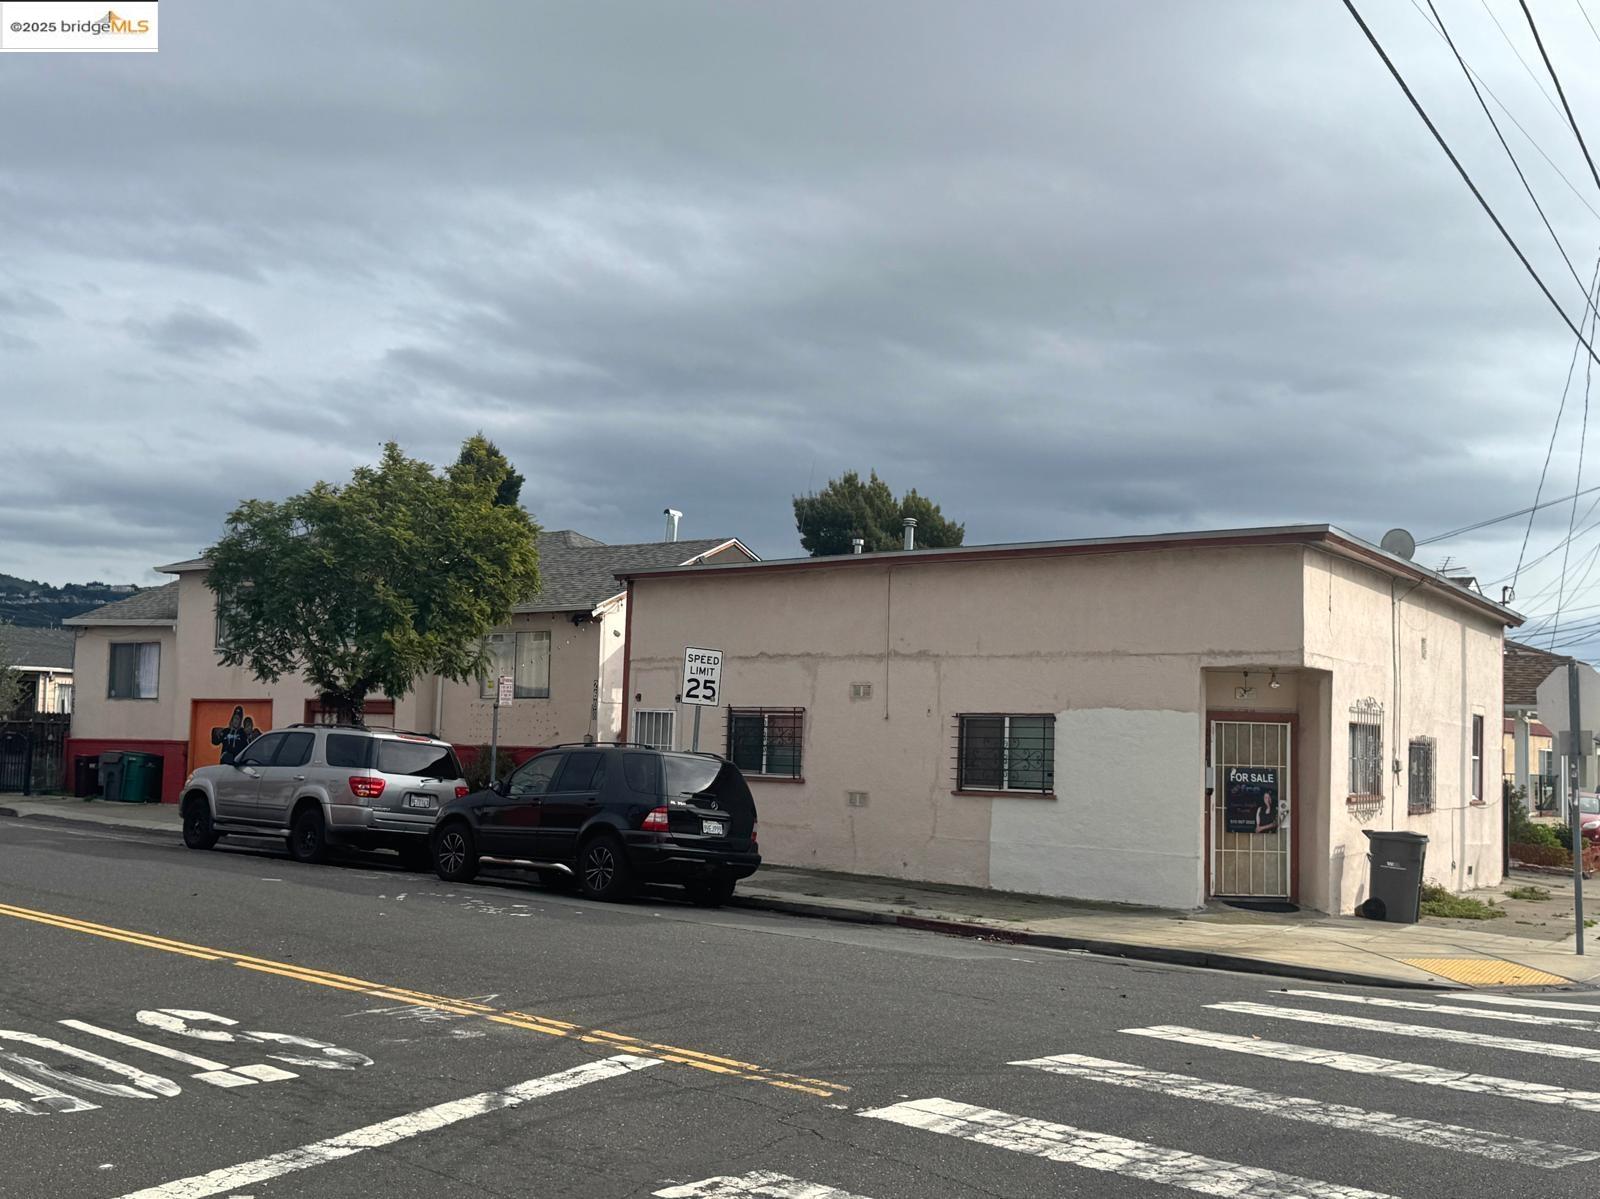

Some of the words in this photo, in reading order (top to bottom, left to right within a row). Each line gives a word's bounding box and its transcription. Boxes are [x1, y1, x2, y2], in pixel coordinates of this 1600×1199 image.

[687, 653, 720, 665] SPEED
[690, 665, 715, 676] LIMIT
[685, 678, 716, 700] 25
[1230, 772, 1249, 782] FOR
[1250, 773, 1274, 783] SALE
